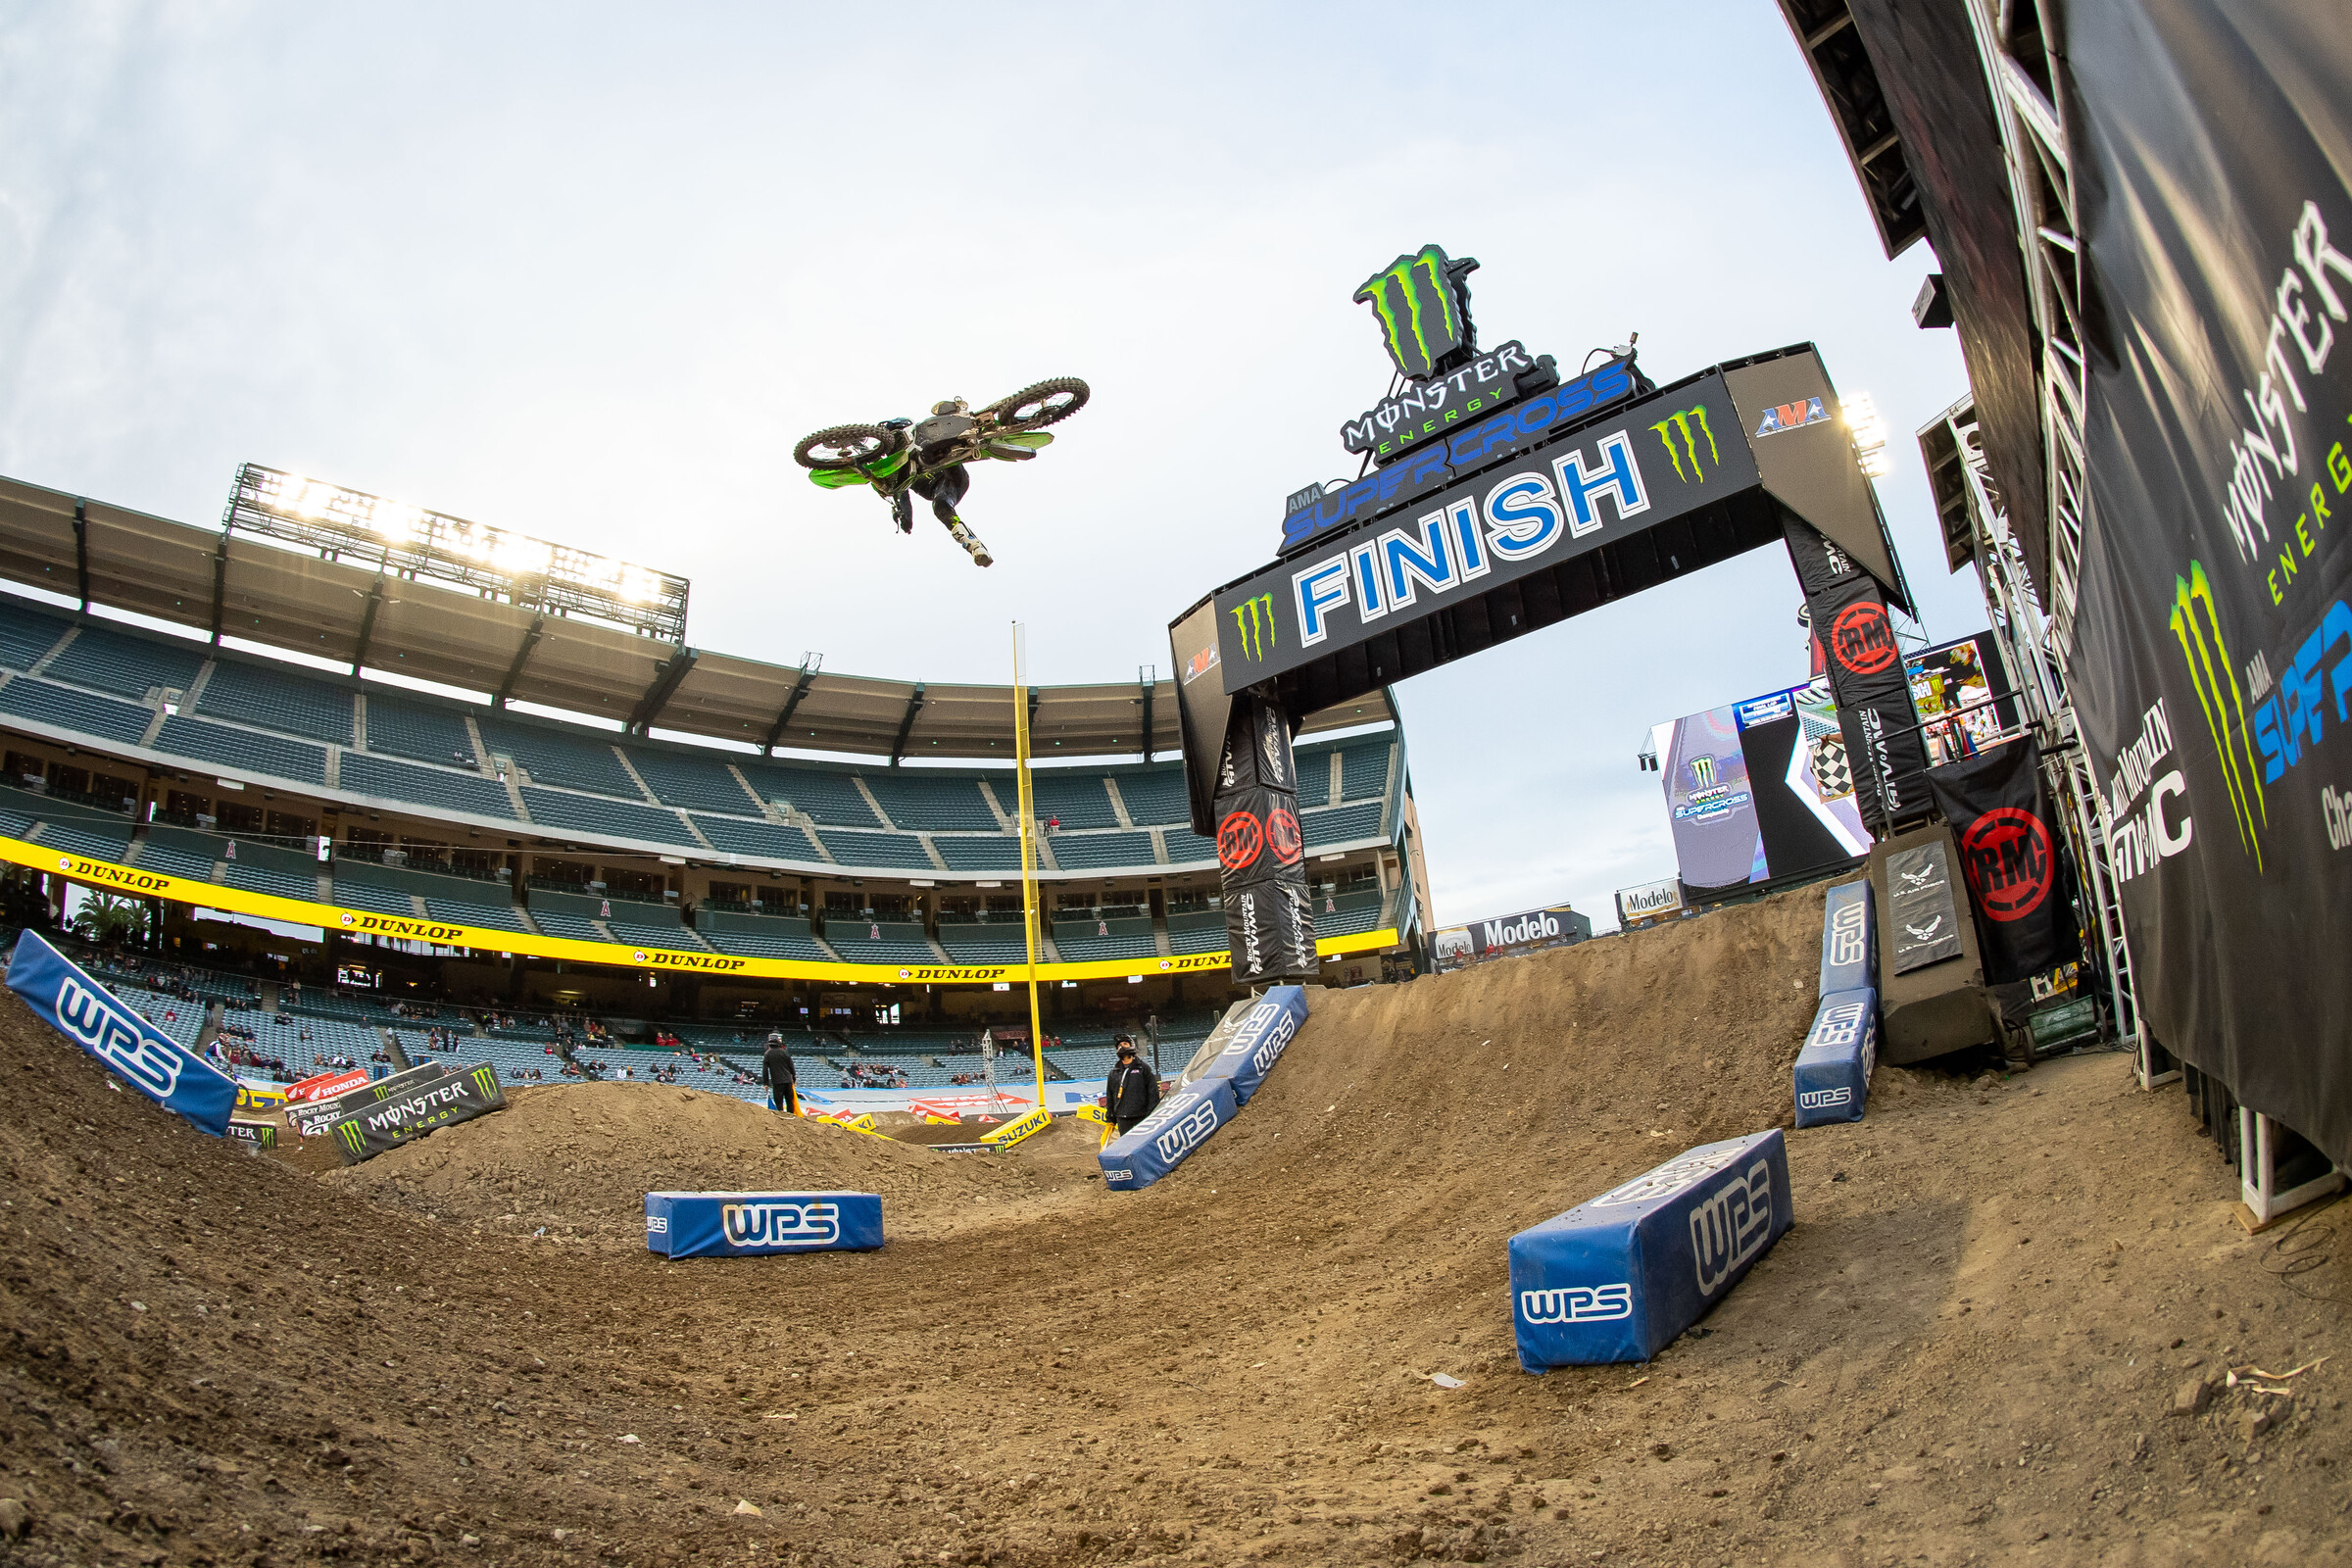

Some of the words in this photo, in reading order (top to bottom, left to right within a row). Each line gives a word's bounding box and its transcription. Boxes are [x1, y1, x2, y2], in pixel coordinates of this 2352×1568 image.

[1345, 343, 1530, 449] MONSTER
[2223, 199, 2352, 565] MONSTER
[1378, 387, 1503, 455] ENERGY
[1754, 396, 1828, 435] AMA
[1283, 360, 1631, 546] SUPERCROSS
[1288, 489, 1321, 514] AMA
[2267, 413, 2352, 607] ENERG
[1292, 428, 1651, 649] FINISH
[2245, 649, 2274, 705] AMA
[2254, 600, 2352, 785] SUPER
[1676, 794, 1748, 819] SUPERCROSS
[75, 862, 171, 891] DUNLOP
[1628, 887, 1674, 911] Modelo
[361, 916, 464, 941] DUNLOP
[1438, 940, 1472, 957] Modelo
[1484, 911, 1559, 948] Modelo
[652, 953, 745, 970] DUNLOP
[915, 968, 1005, 980] DUNLOP
[1177, 955, 1232, 969] DUNL
[55, 976, 183, 1098] WPS
[1223, 1003, 1280, 1055] WPS
[1252, 1010, 1295, 1077] WPS
[321, 1076, 368, 1097] HONDA
[368, 1080, 469, 1132] MONSTER
[1800, 1087, 1851, 1109] WPS
[314, 1111, 341, 1125] ROCKY
[392, 1105, 460, 1139] ENERGY
[998, 1111, 1048, 1146] SUZUKI
[1156, 1100, 1218, 1163] WPS
[722, 1203, 840, 1247] WPS
[1690, 1158, 1773, 1297] WPS
[1521, 1283, 1632, 1324] WPS
